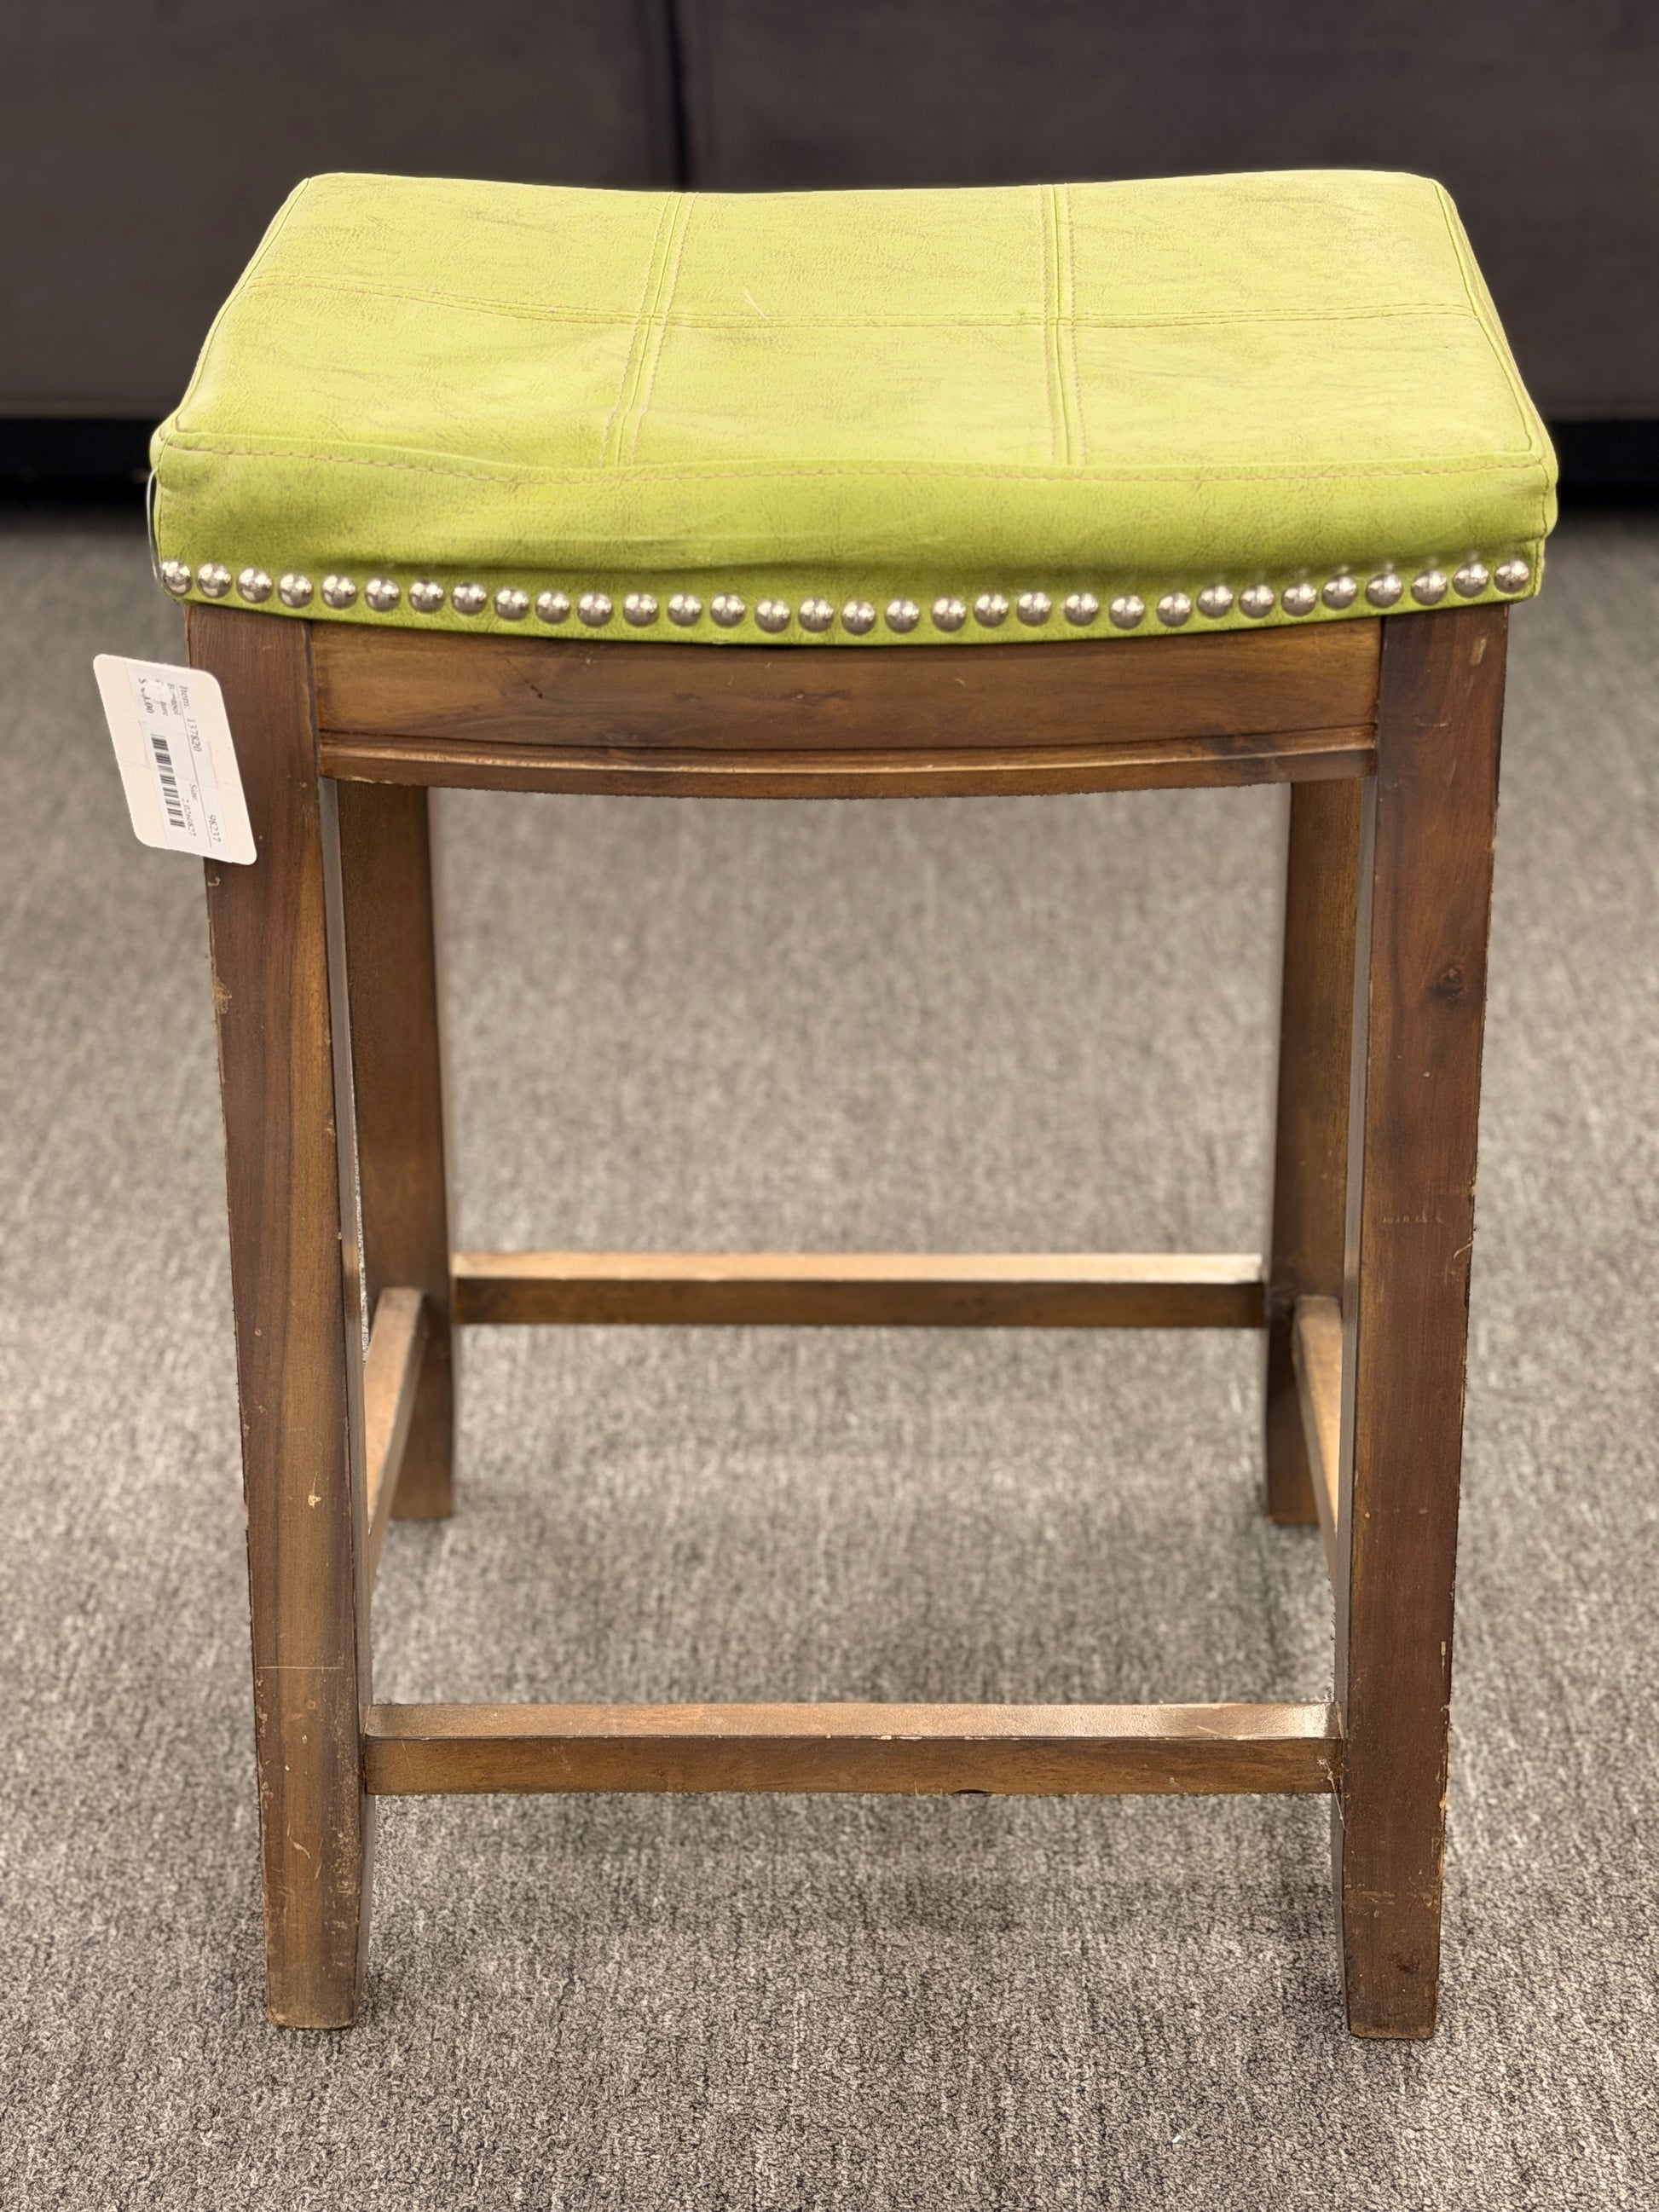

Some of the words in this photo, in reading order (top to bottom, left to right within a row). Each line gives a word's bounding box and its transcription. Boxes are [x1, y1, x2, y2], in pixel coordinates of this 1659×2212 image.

[179, 684, 190, 709] Item:
[187, 718, 202, 752] 137820
[208, 814, 221, 842] 98237
